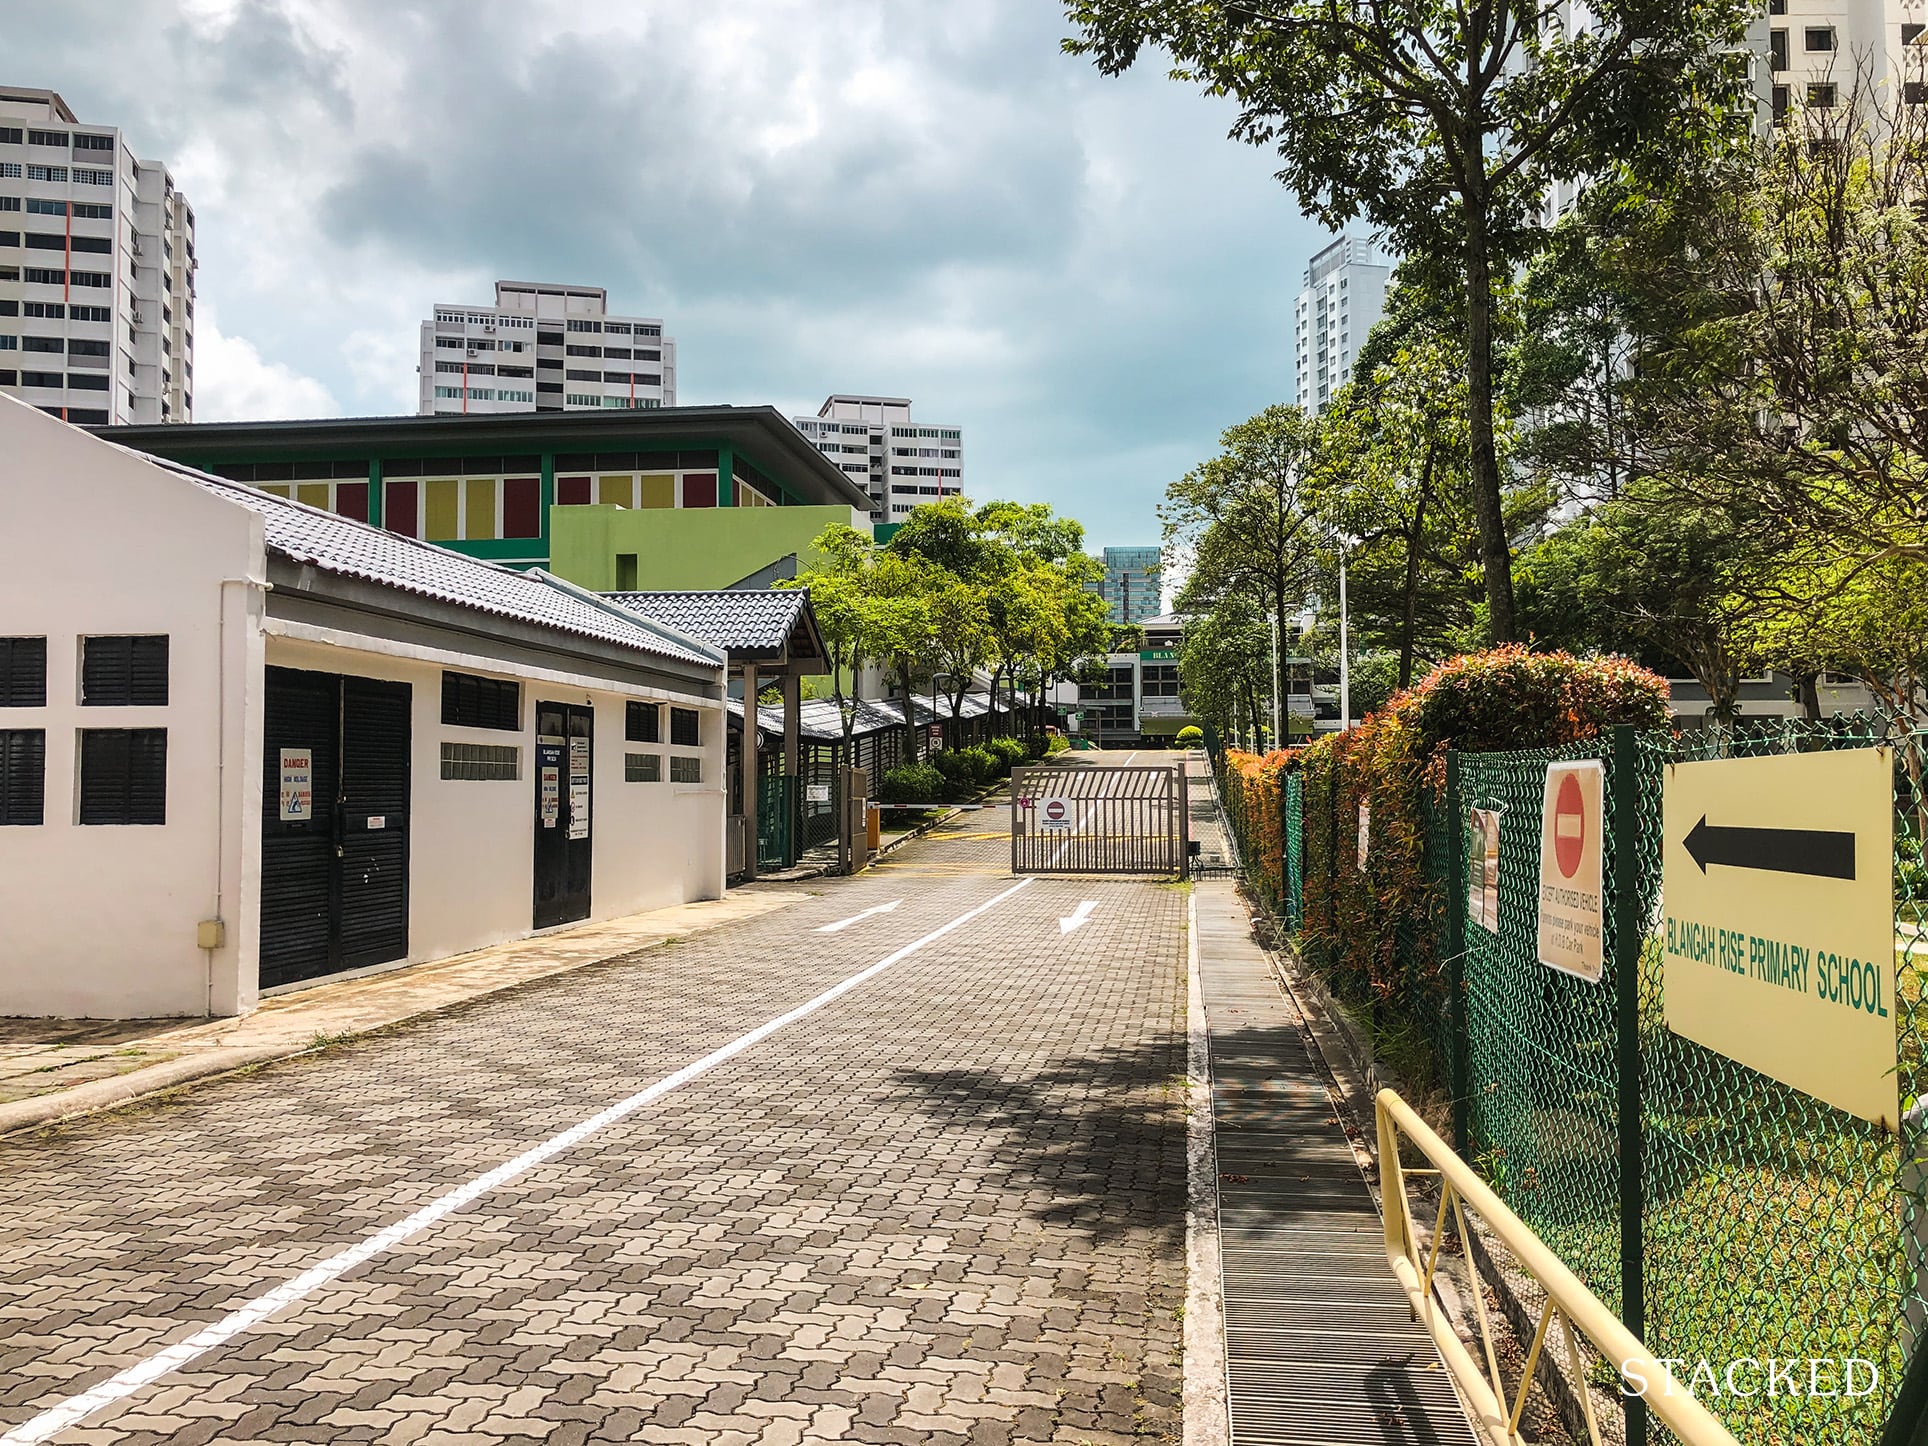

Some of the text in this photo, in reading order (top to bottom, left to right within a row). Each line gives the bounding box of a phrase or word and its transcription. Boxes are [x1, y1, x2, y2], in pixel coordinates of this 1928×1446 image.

[283, 758, 309, 769] DANGER
[1556, 888, 1579, 909] AUTHORISED
[1580, 892, 1599, 913] VEHICLE
[1574, 921, 1584, 937] your
[1584, 924, 1599, 938] vehicle
[1574, 938, 1584, 955] Park
[1667, 917, 1889, 1019] BLANGAH RISE PRIMARY SCHOOL
